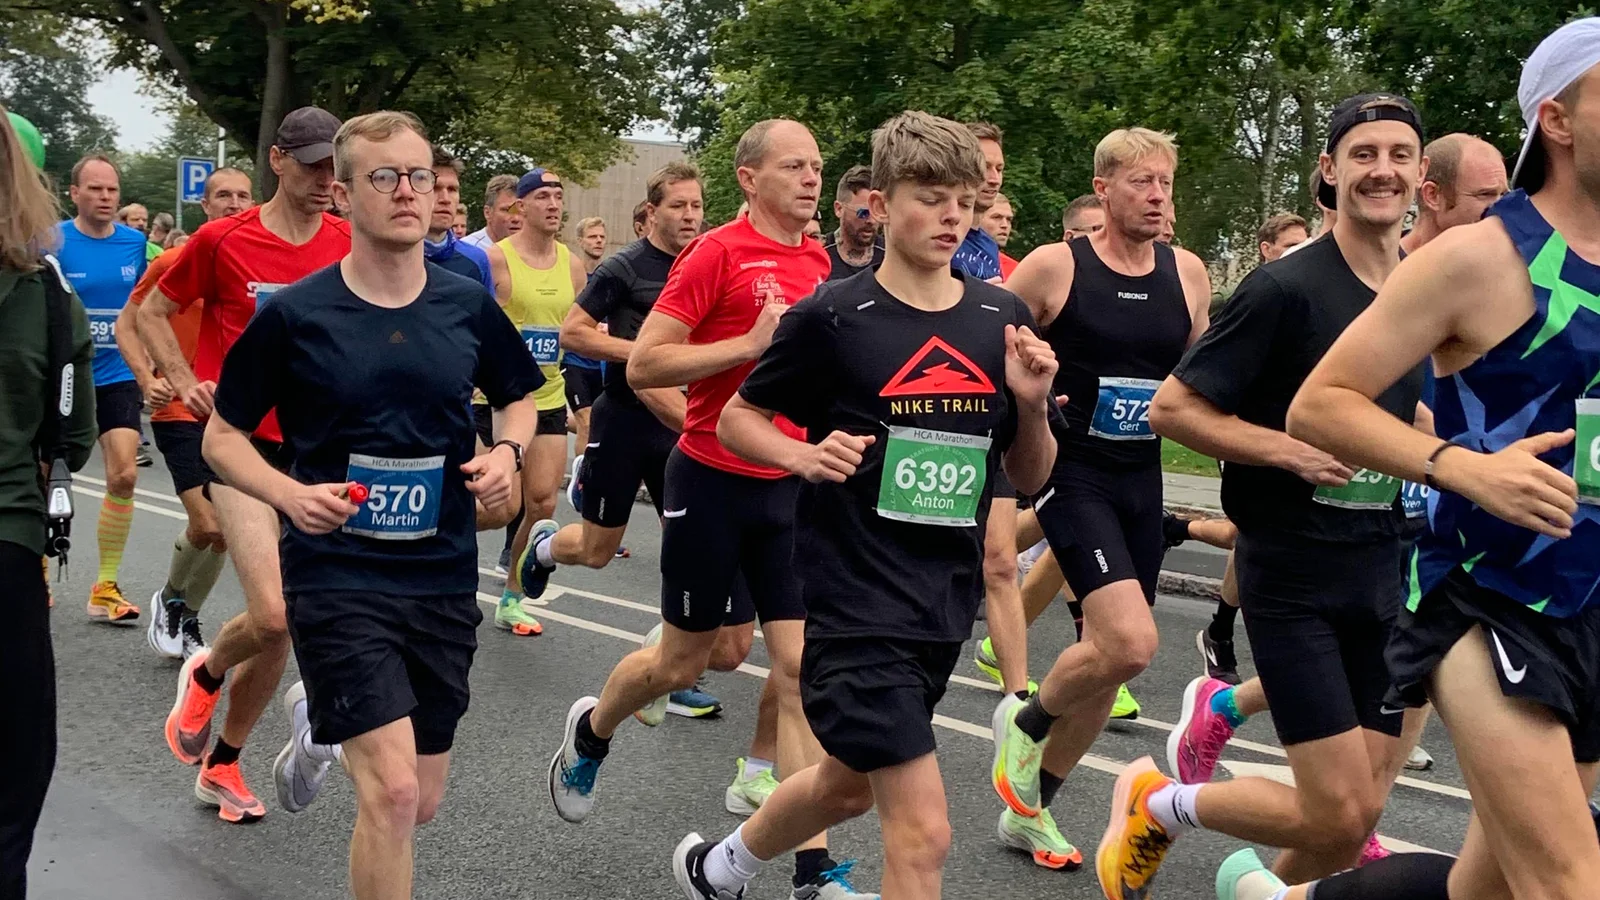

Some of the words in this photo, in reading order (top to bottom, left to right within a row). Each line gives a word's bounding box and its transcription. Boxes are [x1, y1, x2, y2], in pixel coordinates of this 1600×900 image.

[190, 165, 207, 190] P
[525, 337, 557, 353] 1152
[890, 400, 935, 415] NIKE
[941, 398, 990, 413] TRAIL
[1111, 398, 1152, 422] 572
[1118, 420, 1141, 432] Gert
[913, 429, 933, 440] HCA
[935, 432, 973, 445] Marathon
[372, 458, 390, 468] HCA
[391, 459, 430, 469] Marathon
[895, 457, 977, 496] 6392
[367, 483, 427, 513] 570
[911, 492, 955, 510] Anton
[371, 511, 420, 527] Martin
